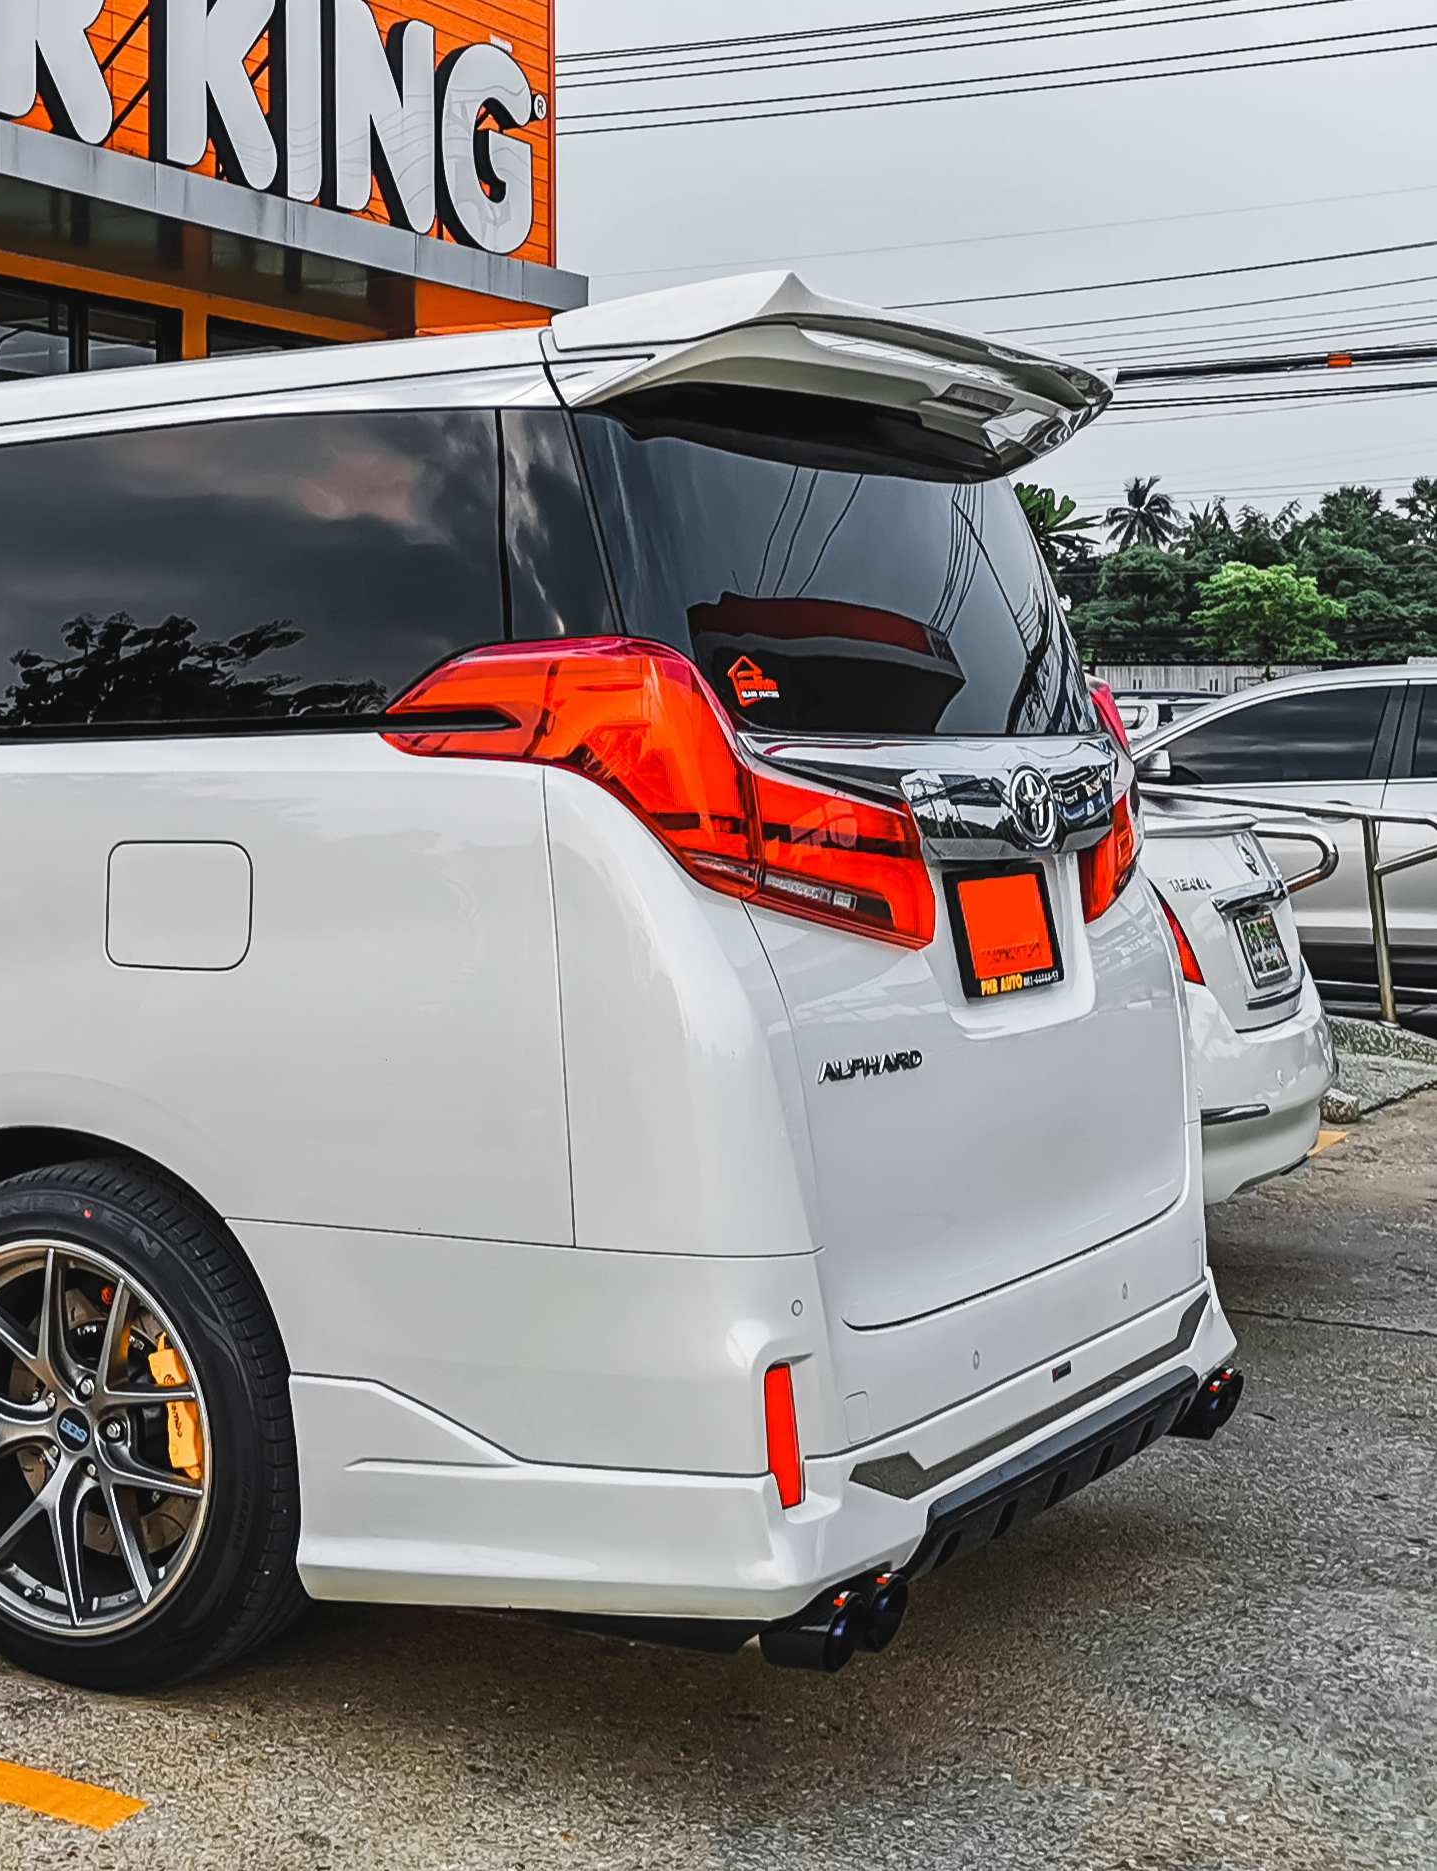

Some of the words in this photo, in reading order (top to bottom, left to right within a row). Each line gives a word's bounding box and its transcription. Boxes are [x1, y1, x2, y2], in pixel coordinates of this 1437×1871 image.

[166, 0, 534, 255] KING
[1000, 973, 1023, 992] AUTO
[818, 1049, 923, 1084] ALPHARD
[59, 1417, 88, 1443] BBS
